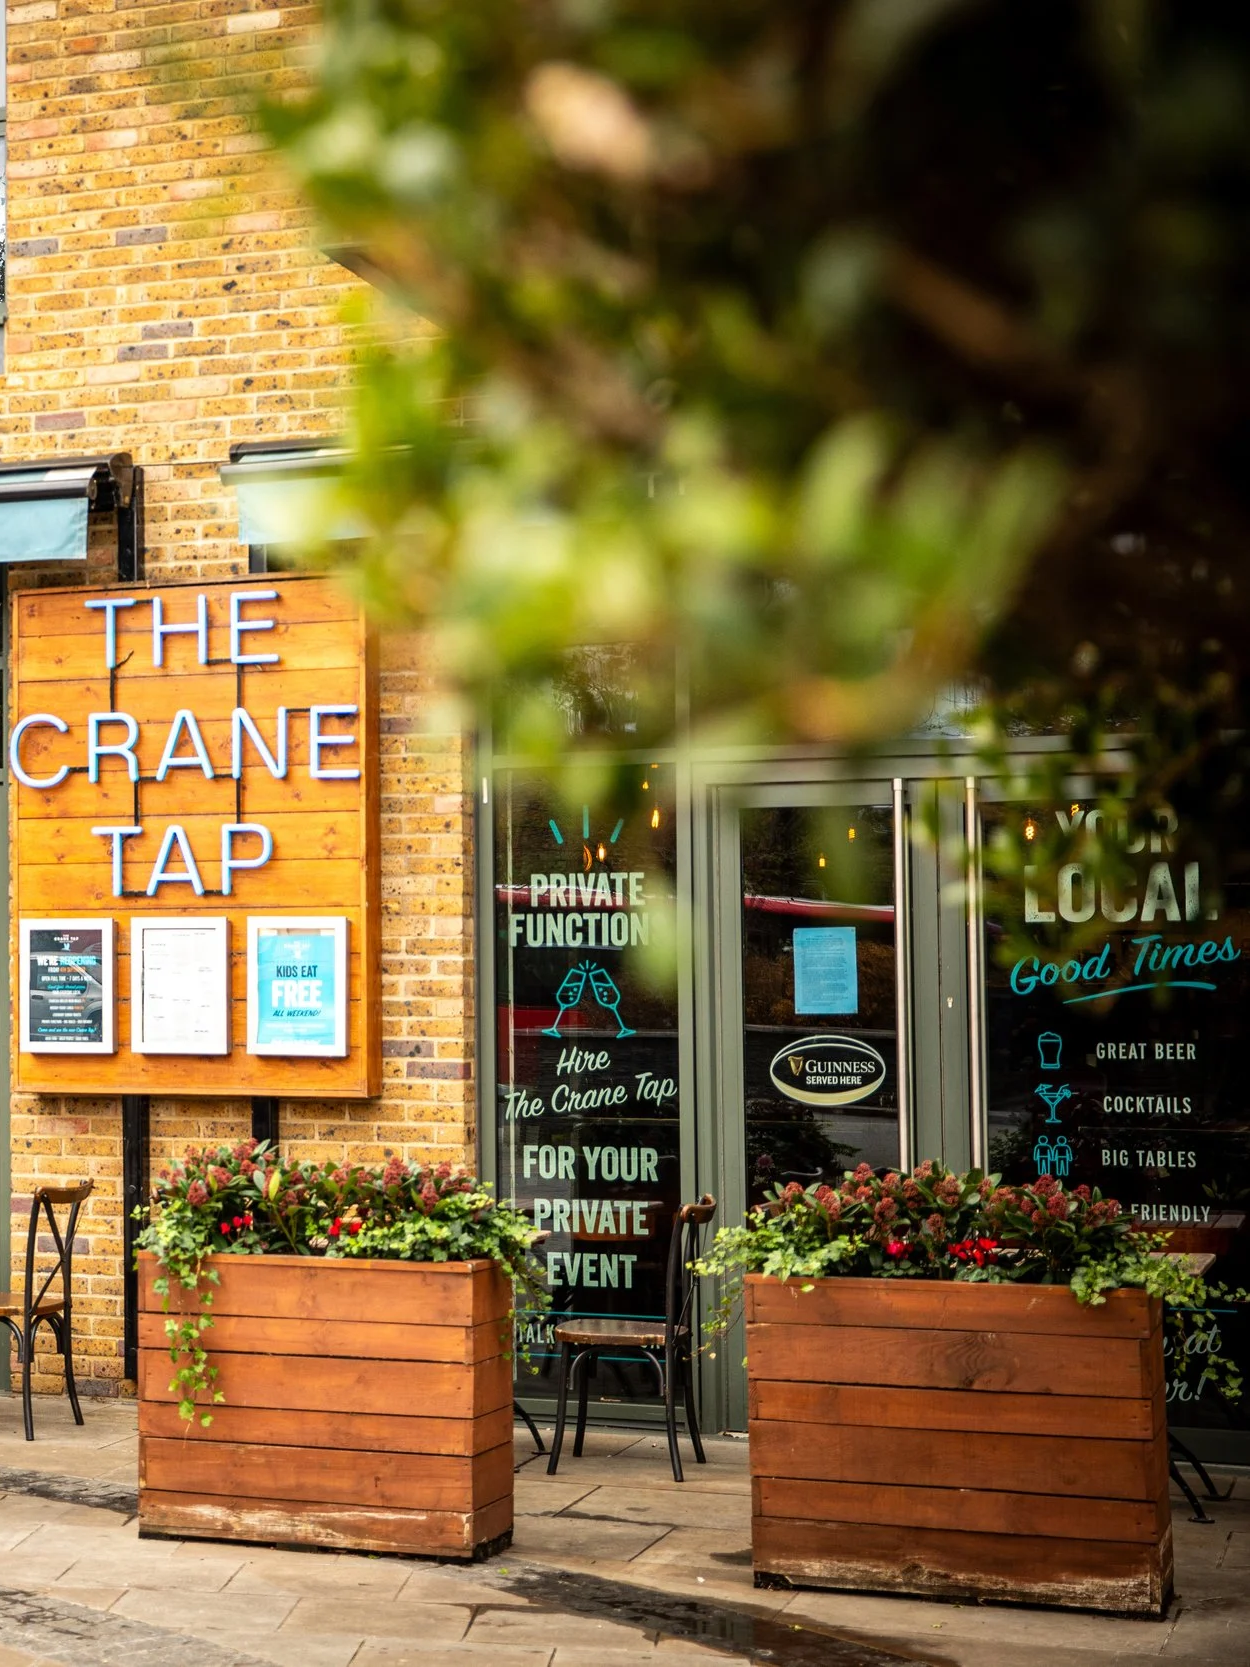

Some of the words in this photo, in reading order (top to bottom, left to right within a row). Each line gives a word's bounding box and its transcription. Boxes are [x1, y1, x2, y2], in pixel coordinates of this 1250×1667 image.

[84, 590, 281, 669] THE
[10, 704, 361, 789] CRANE
[90, 823, 273, 897] TAP
[530, 872, 646, 908] PRIVATE
[509, 912, 658, 948] FUNCTION
[276, 965, 298, 978] KIDS
[301, 965, 318, 978] EAT
[1010, 942, 1111, 995] Good
[1131, 934, 1242, 976] Times
[271, 980, 323, 1008] FREE
[273, 1009, 284, 1017] ALL
[286, 1009, 322, 1017] WEEKEND!
[556, 1046, 611, 1076] Hire
[805, 1059, 875, 1073] GUINNESS
[1096, 1042, 1147, 1060] GREAT
[1155, 1043, 1196, 1060] BEER
[504, 1089, 545, 1120] The
[551, 1084, 628, 1112] Crane
[635, 1072, 677, 1106] Tap
[806, 1076, 838, 1085] SERVED
[840, 1076, 862, 1085] HERE
[1103, 1096, 1192, 1114] COCKTAILS
[523, 1145, 576, 1180] FOR
[582, 1145, 658, 1182] YOUR
[1102, 1149, 1129, 1167] BIG
[1136, 1150, 1197, 1168] TABLES
[534, 1198, 649, 1236] PRIVATE
[1131, 1203, 1210, 1223] FRIENDLY
[547, 1251, 637, 1289] EVENT
